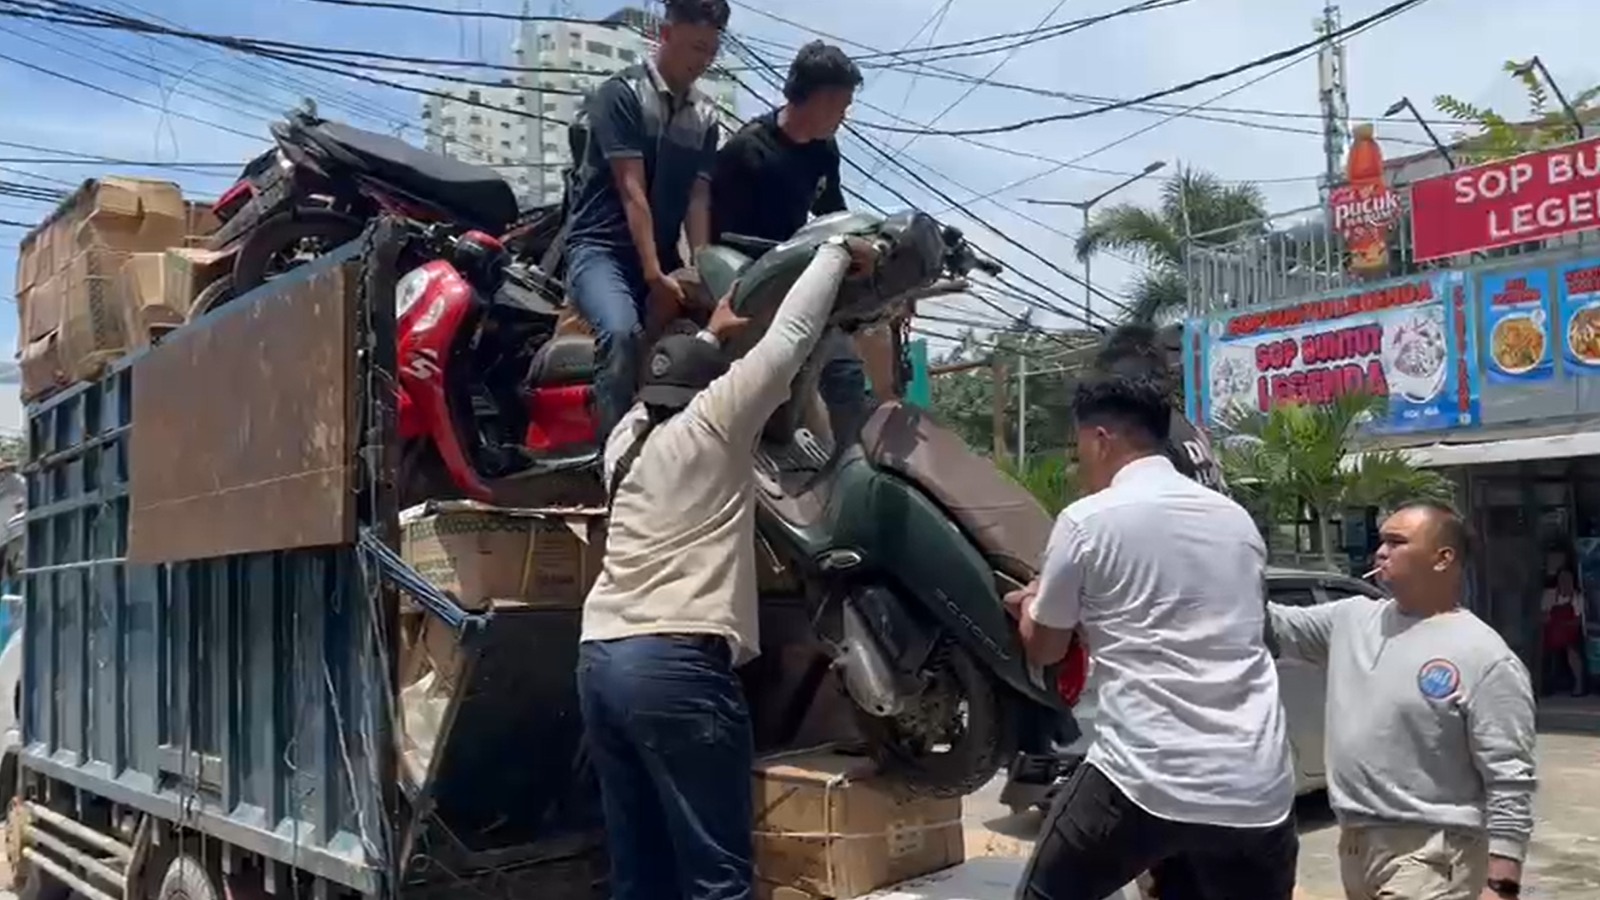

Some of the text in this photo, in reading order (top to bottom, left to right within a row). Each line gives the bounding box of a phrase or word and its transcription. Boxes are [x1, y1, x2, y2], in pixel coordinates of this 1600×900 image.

[1455, 163, 1533, 204] SOP
[1489, 189, 1600, 241] LEGE
[1255, 322, 1383, 373] SOP BUNTUT
[1257, 359, 1389, 413] LEGENDA
